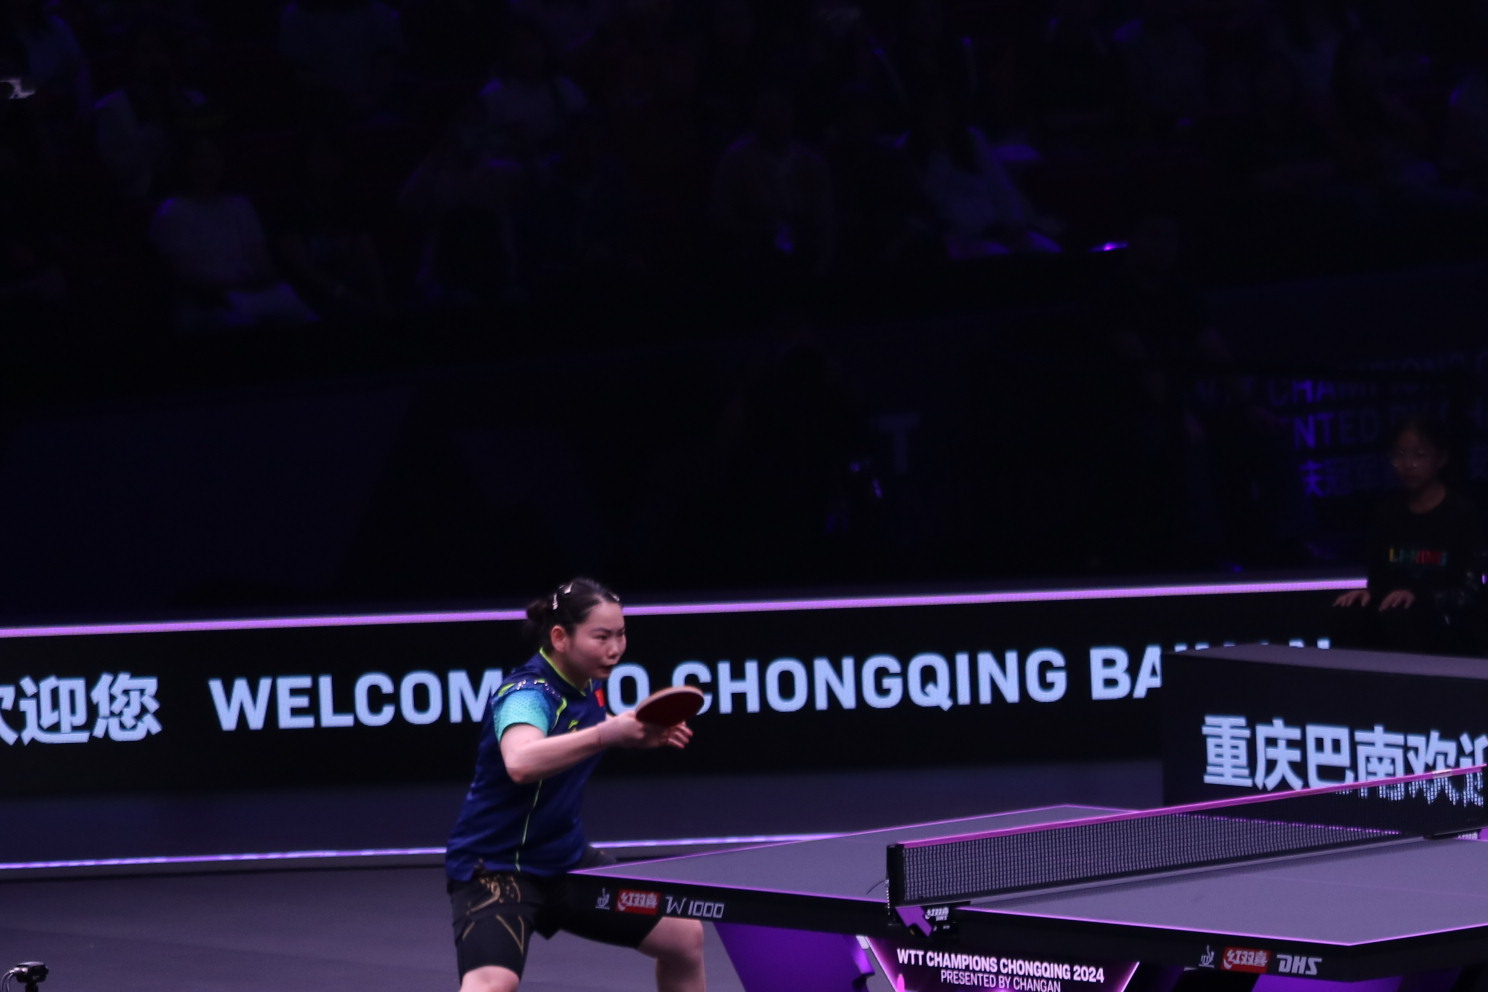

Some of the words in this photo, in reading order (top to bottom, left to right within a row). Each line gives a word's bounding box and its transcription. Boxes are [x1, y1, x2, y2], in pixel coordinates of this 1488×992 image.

[208, 668, 503, 732] WELCOM
[607, 662, 651, 717] O
[897, 948, 925, 966] WTT
[926, 951, 998, 973] CHAMPIONS
[999, 958, 1072, 980] CHONGQING
[1073, 965, 1105, 983] 2024
[1276, 953, 1323, 976] DHS
[940, 969, 997, 988] PRESENTED
[999, 976, 1013, 990] BY
